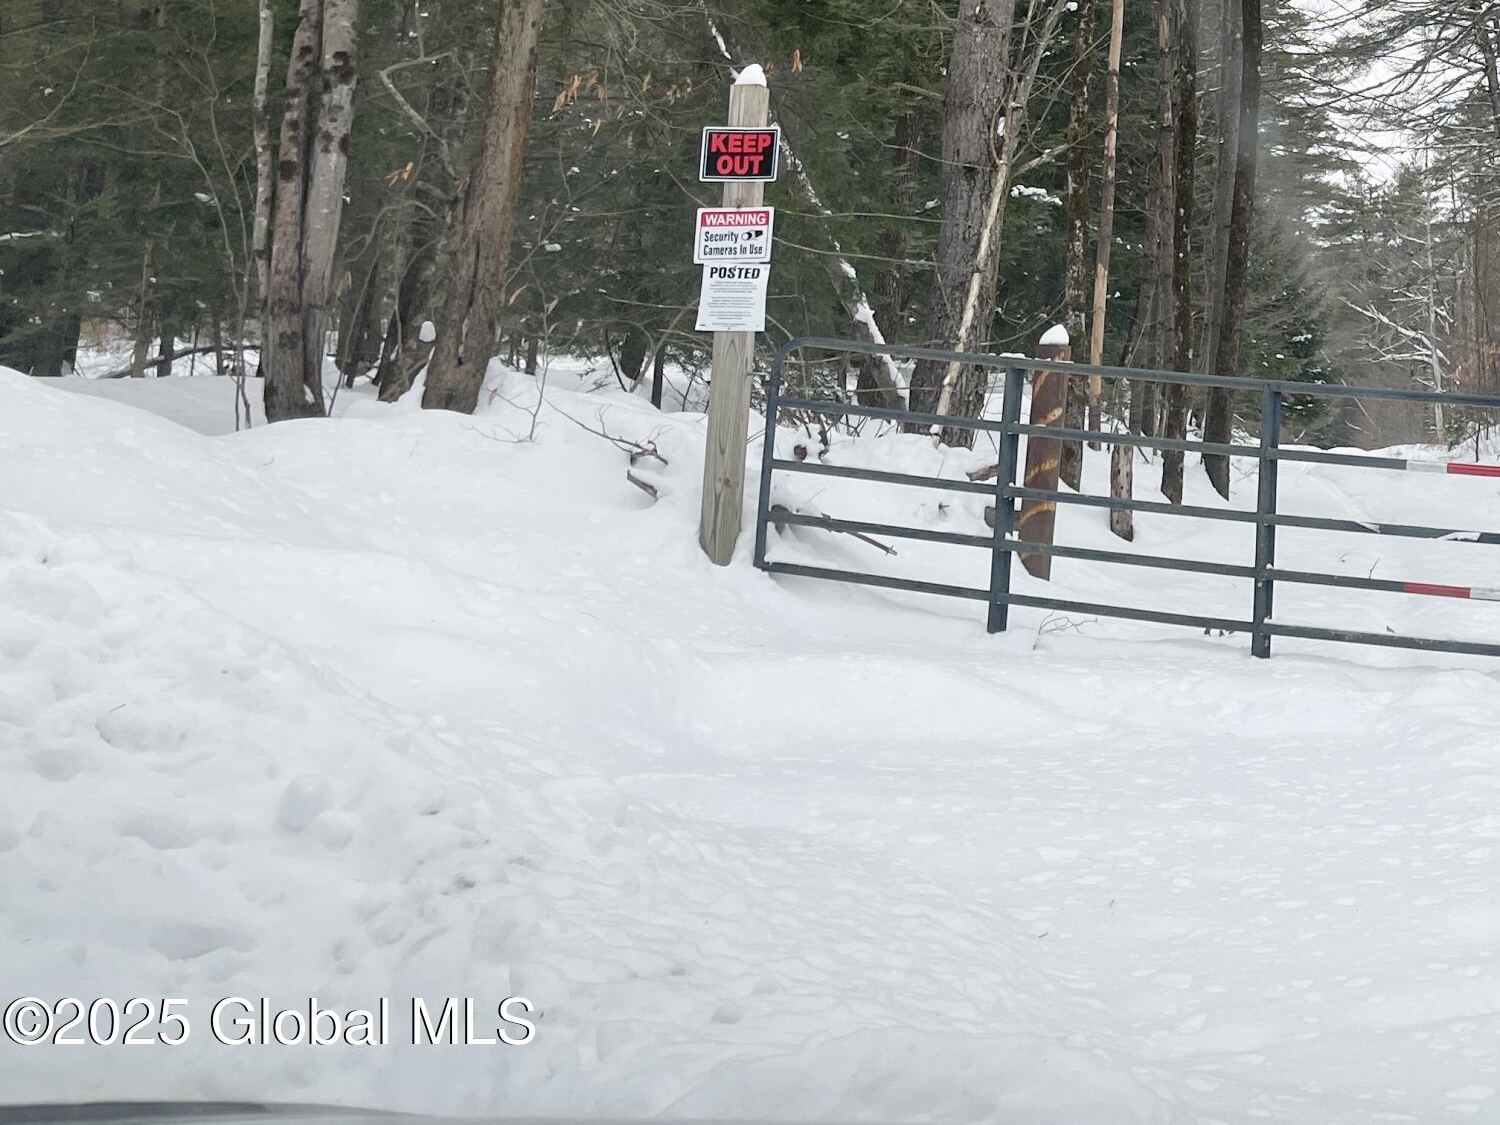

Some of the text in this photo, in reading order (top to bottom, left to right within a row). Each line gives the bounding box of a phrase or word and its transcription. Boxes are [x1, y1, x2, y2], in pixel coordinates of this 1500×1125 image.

[711, 133, 772, 154] KEEP
[716, 155, 764, 175] OUT
[705, 212, 767, 226] WARNING
[704, 230, 739, 244] Security
[703, 244, 763, 256] Cameras In Use
[710, 266, 761, 279] POSTED
